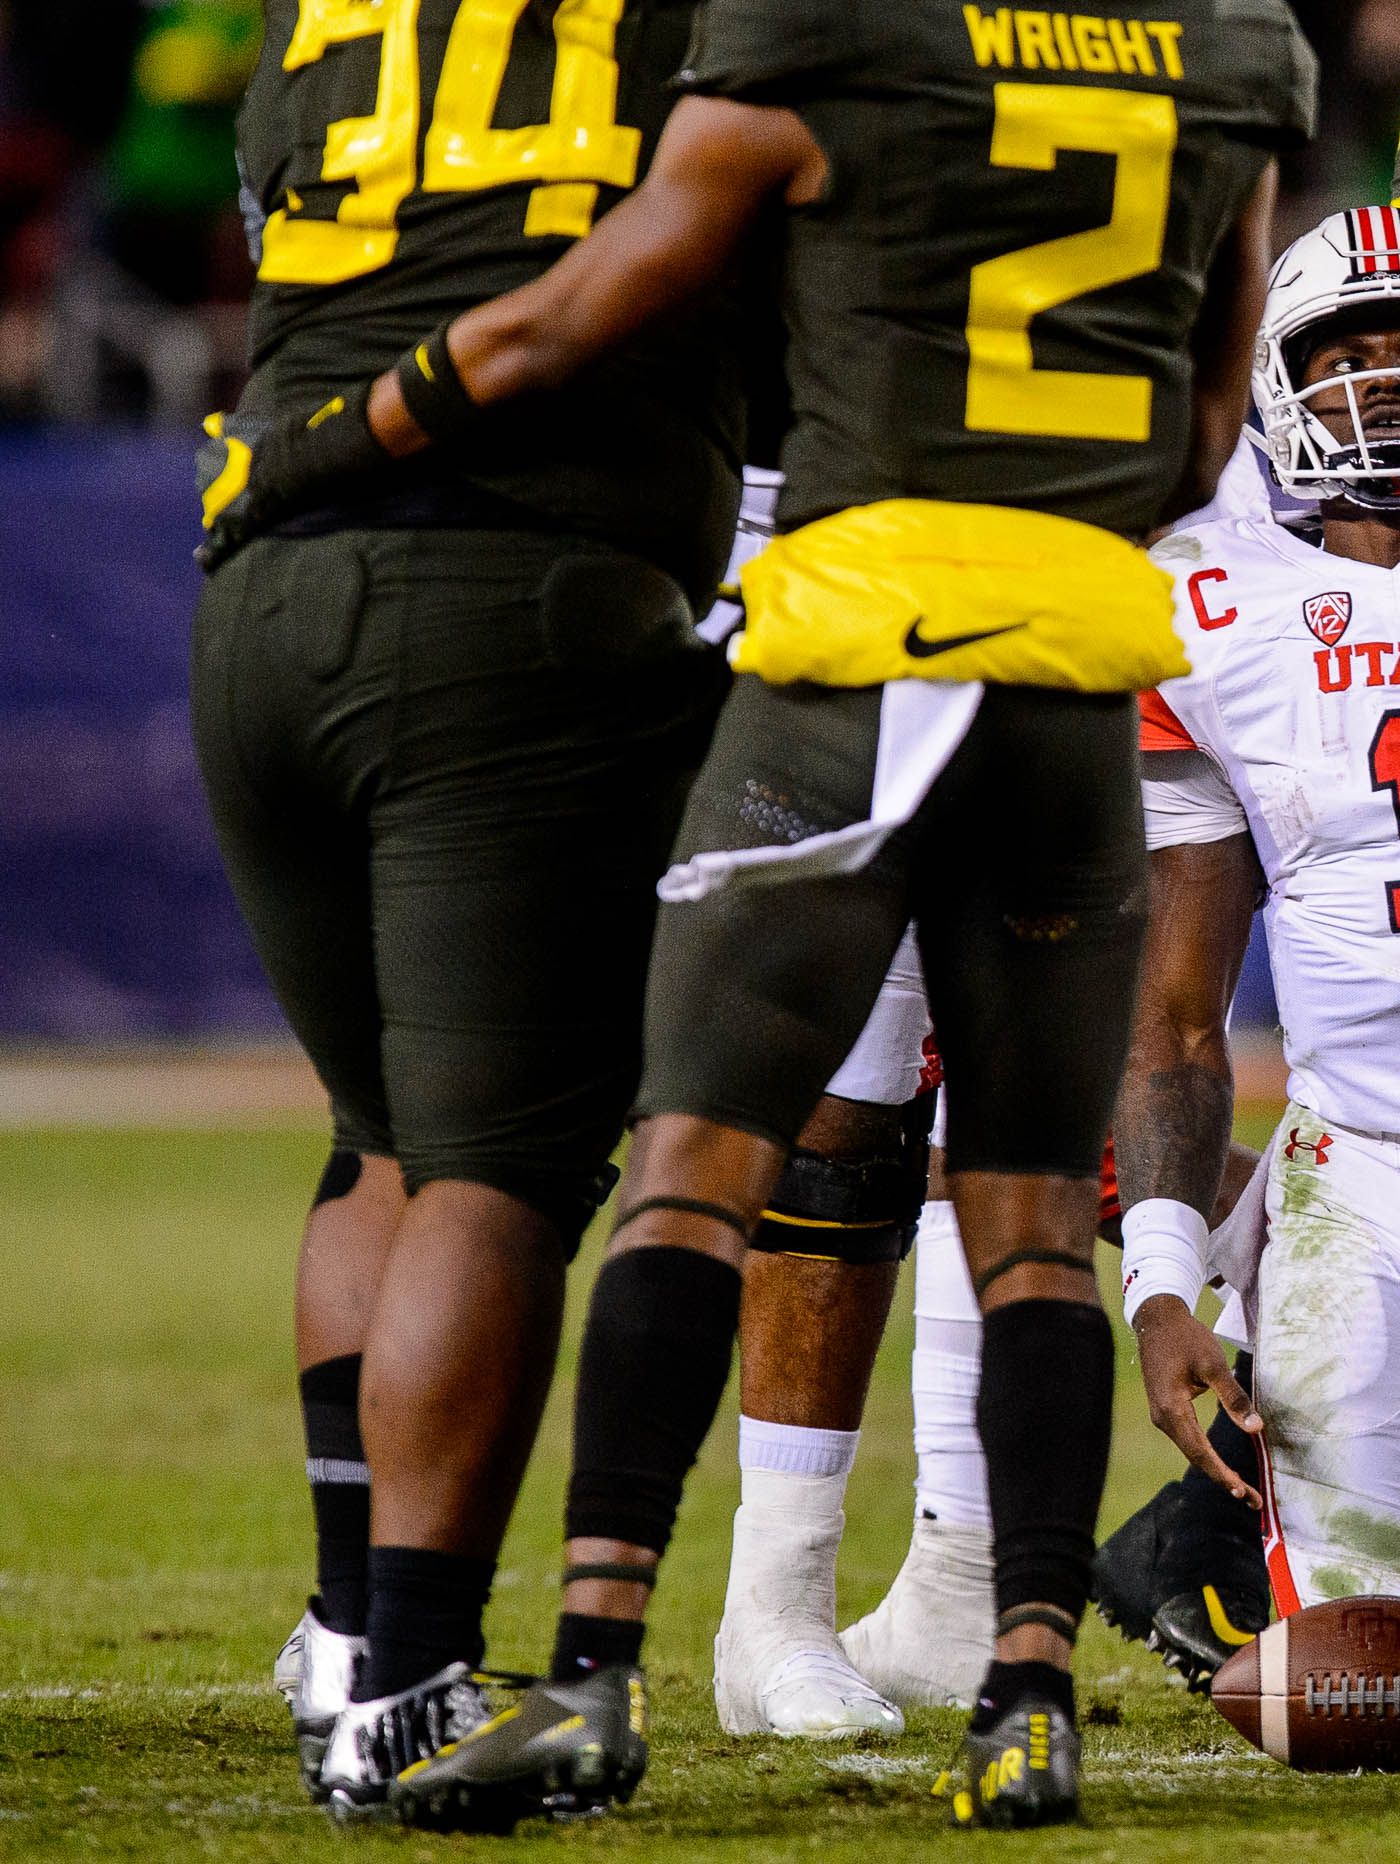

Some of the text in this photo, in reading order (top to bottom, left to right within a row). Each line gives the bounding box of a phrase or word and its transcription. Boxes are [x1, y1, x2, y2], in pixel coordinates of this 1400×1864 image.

[962, 3, 1185, 80] WRIGHT
[964, 82, 1178, 443] 2
[1187, 567, 1238, 631] C
[1305, 592, 1350, 629] PAC
[1317, 613, 1343, 637] 12
